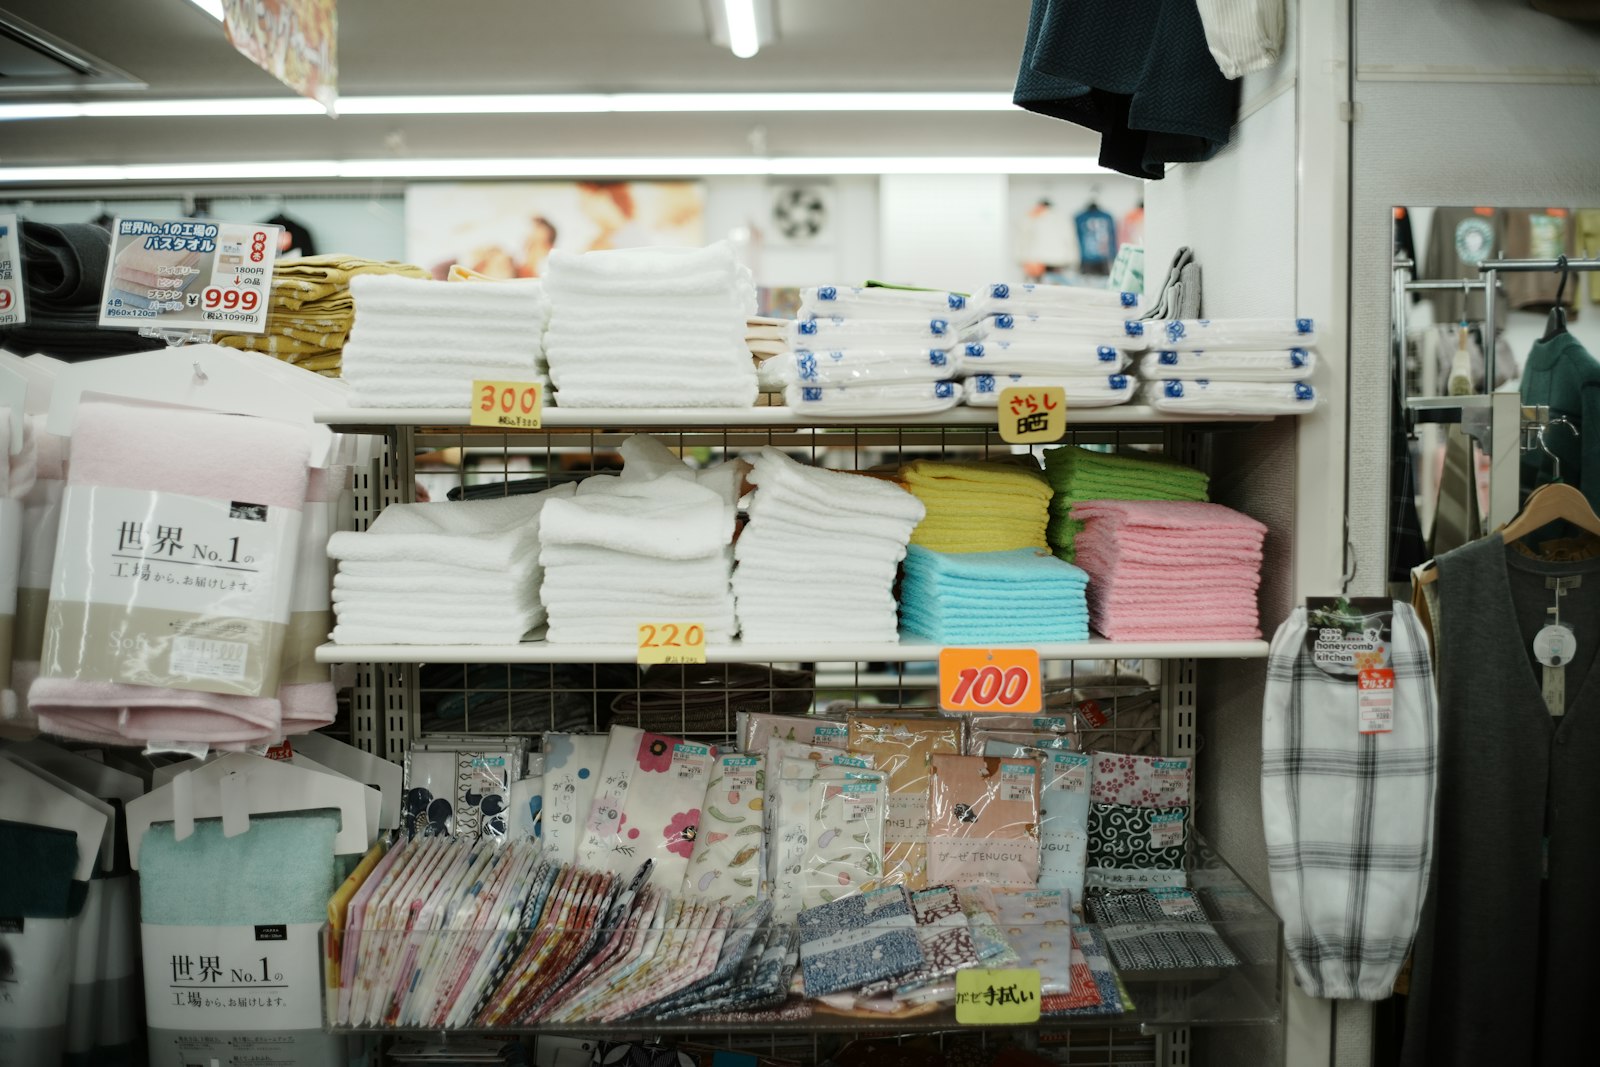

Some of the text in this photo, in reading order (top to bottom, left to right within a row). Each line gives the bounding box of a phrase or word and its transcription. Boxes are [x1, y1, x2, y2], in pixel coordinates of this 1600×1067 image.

[120, 221, 218, 237] 世界No.1の工場の
[145, 237, 216, 252] バスタオル
[235, 267, 264, 275] 1800円
[149, 290, 182, 299] ブラウン
[107, 299, 122, 307] 4色
[481, 386, 536, 414] 300
[1010, 393, 1057, 415] さらし
[117, 521, 184, 556] 世界
[640, 624, 704, 648] 220
[1316, 641, 1374, 651] honeycomb
[1316, 652, 1352, 661] kitchen
[950, 666, 1030, 706] 100
[1361, 679, 1392, 689] マルエイ
[938, 851, 1023, 862] がーぜ TENUGUI
[170, 955, 223, 982] 世界
[171, 991, 287, 1007] 工場から、お届けします。
